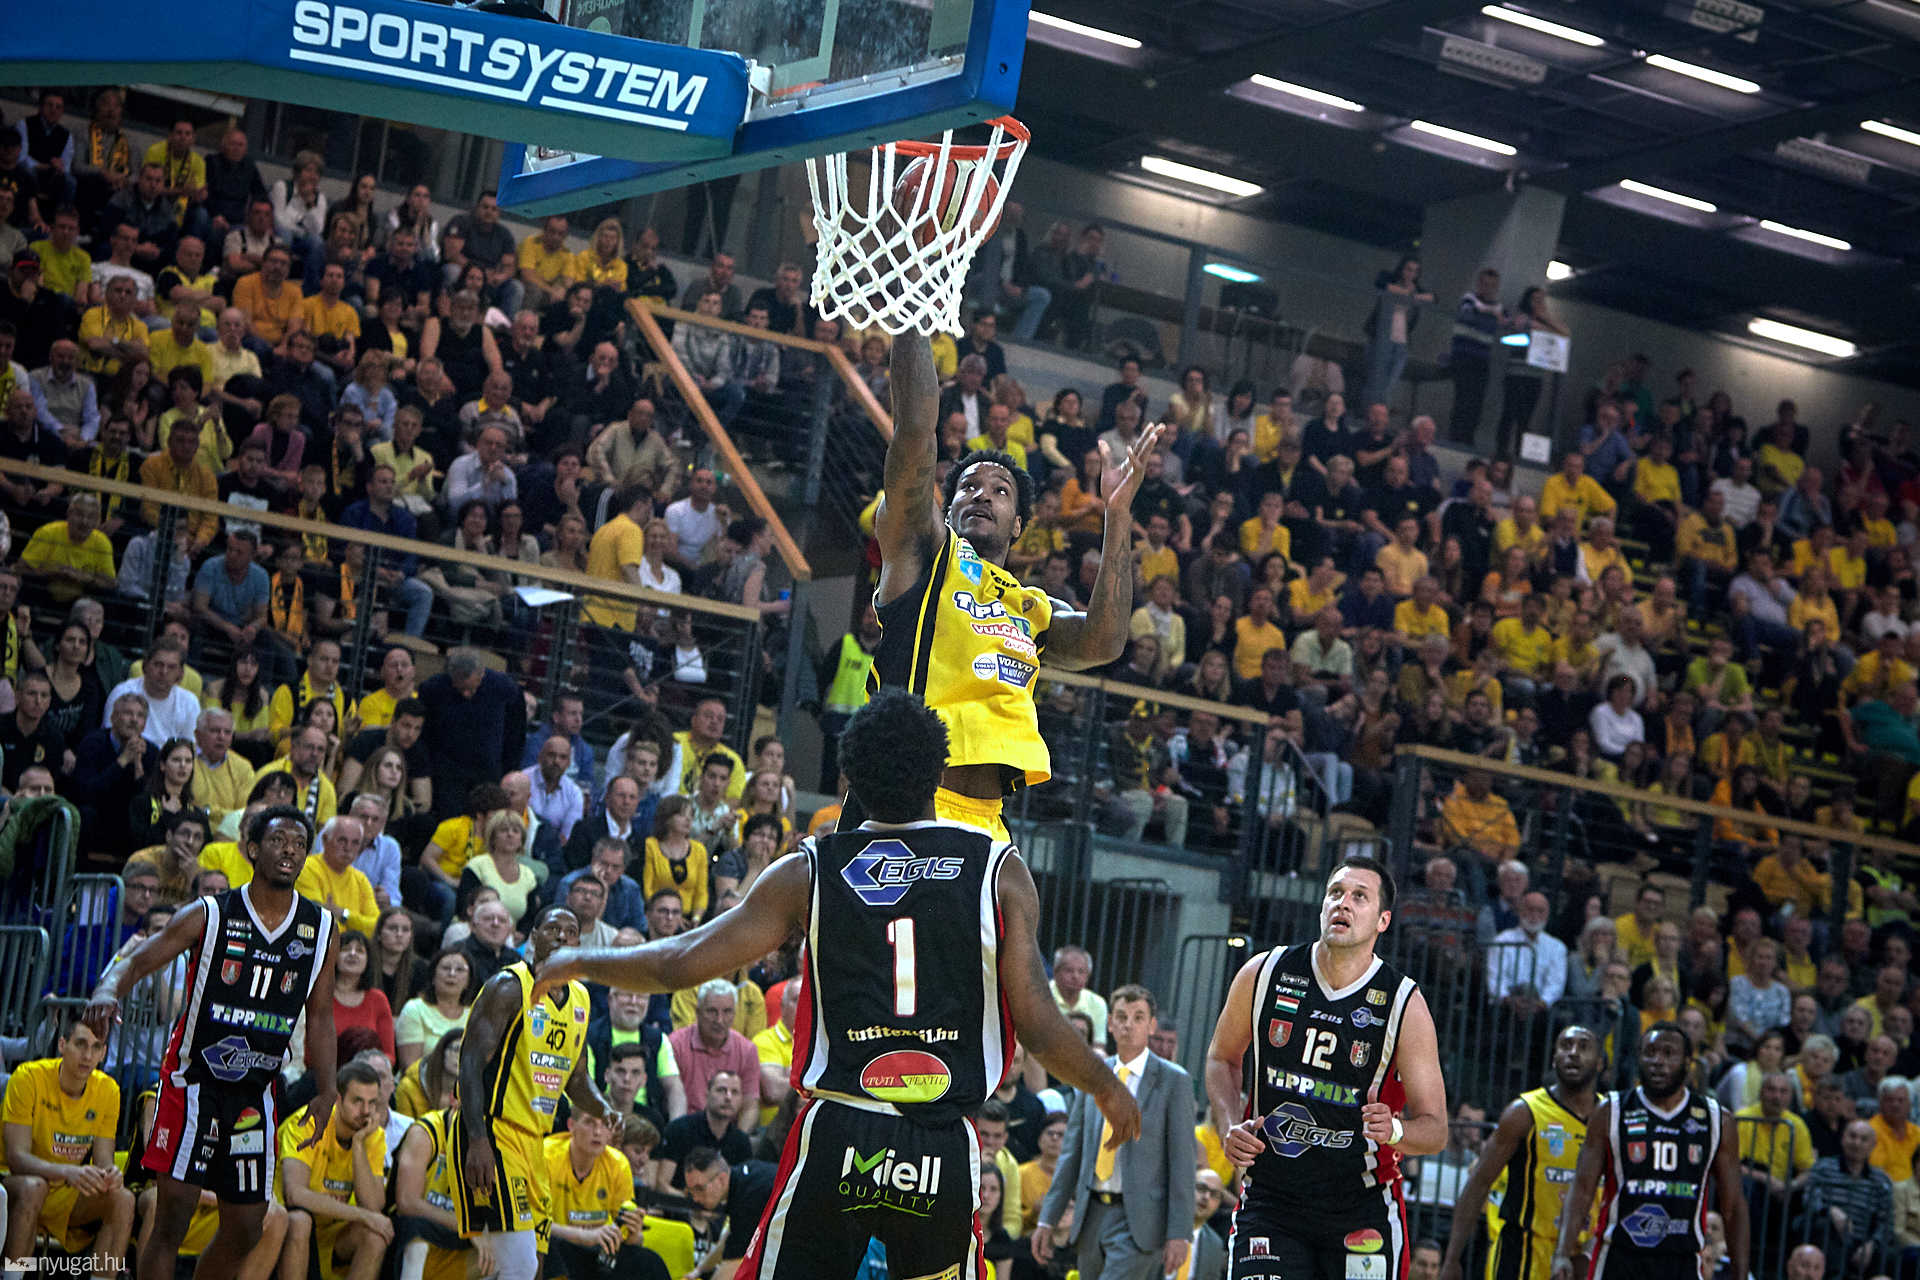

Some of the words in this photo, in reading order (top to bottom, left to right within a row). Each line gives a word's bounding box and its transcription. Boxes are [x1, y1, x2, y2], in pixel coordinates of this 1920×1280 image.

[998, 655, 1034, 672] VOLVO
[878, 857, 964, 883] EGIS
[252, 949, 282, 963] Zeus
[886, 917, 917, 1017] 1
[249, 965, 273, 1000] 11
[1309, 1009, 1345, 1025] Zeus
[545, 1028, 566, 1051] 40
[1301, 1027, 1338, 1071] 12
[866, 1076, 896, 1088] TUTI
[1285, 1119, 1355, 1150] EGIS
[840, 1145, 942, 1195] Miell
[1651, 1140, 1678, 1172] 10
[235, 1159, 258, 1192] 11
[838, 1181, 936, 1212] QUALITY
